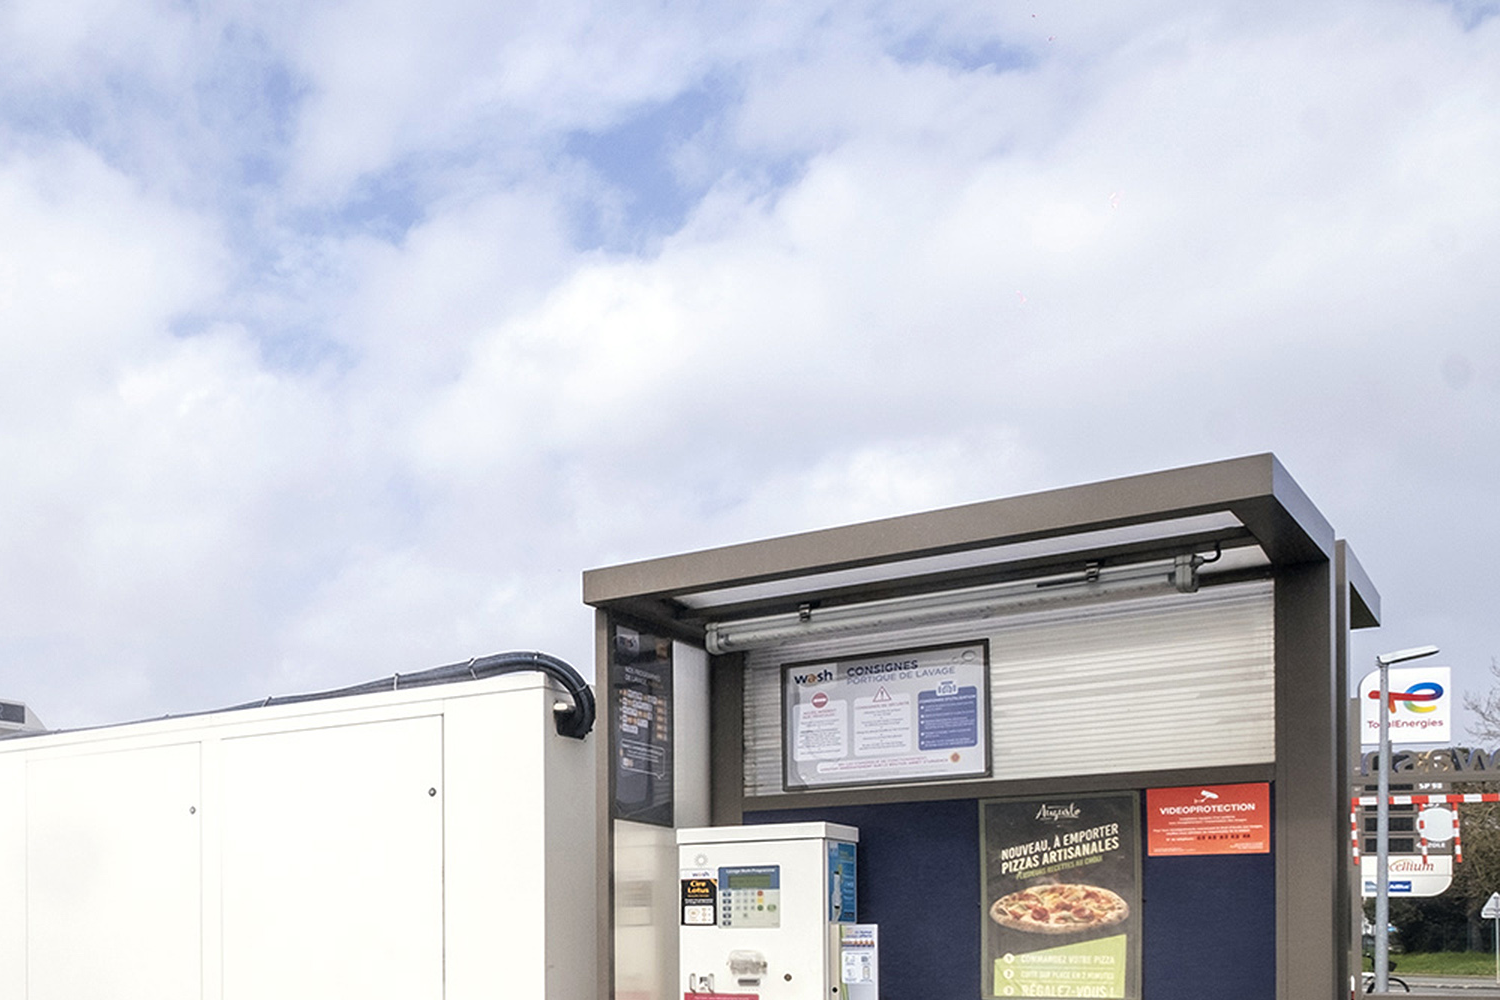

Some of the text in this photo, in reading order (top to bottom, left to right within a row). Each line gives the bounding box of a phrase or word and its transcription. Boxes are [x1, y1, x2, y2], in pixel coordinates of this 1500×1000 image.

[794, 669, 833, 685] wash
[846, 660, 919, 677] CONSIGNES
[846, 666, 956, 685] PORTIQUE DE LAVAGE
[1159, 803, 1256, 815] VIDEOPROTECTION
[1053, 834, 1061, 849] À
[1063, 823, 1119, 846] EMPORTER
[1001, 836, 1120, 875] PIZZAS ARTISANALES
[1094, 955, 1115, 964] PIZZA
